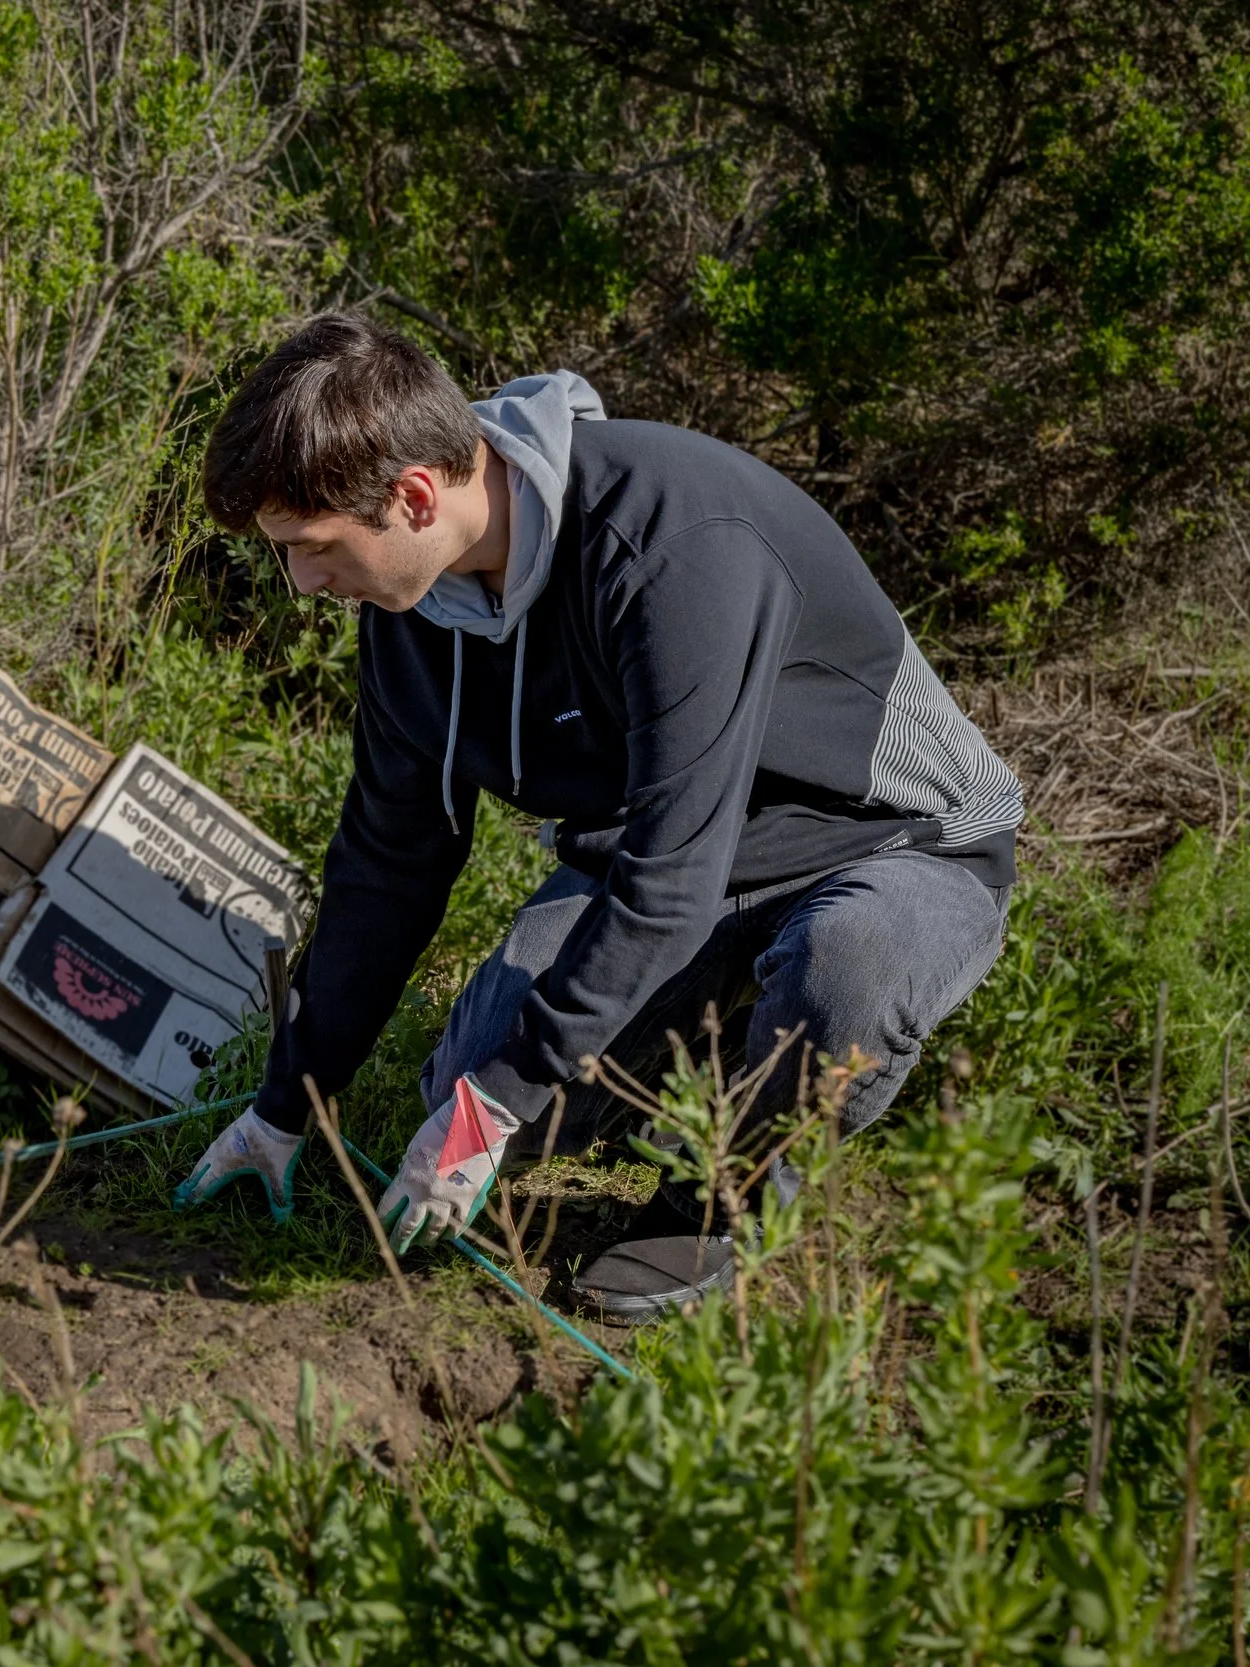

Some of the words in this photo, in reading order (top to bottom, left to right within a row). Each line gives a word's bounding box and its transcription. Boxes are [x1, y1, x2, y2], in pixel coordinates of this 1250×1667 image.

[137, 768, 215, 838] Potato
[117, 801, 200, 873] Potatoes
[131, 837, 189, 891] Idaho
[52, 940, 114, 989] SUPREME
[112, 984, 143, 1008] SUN
